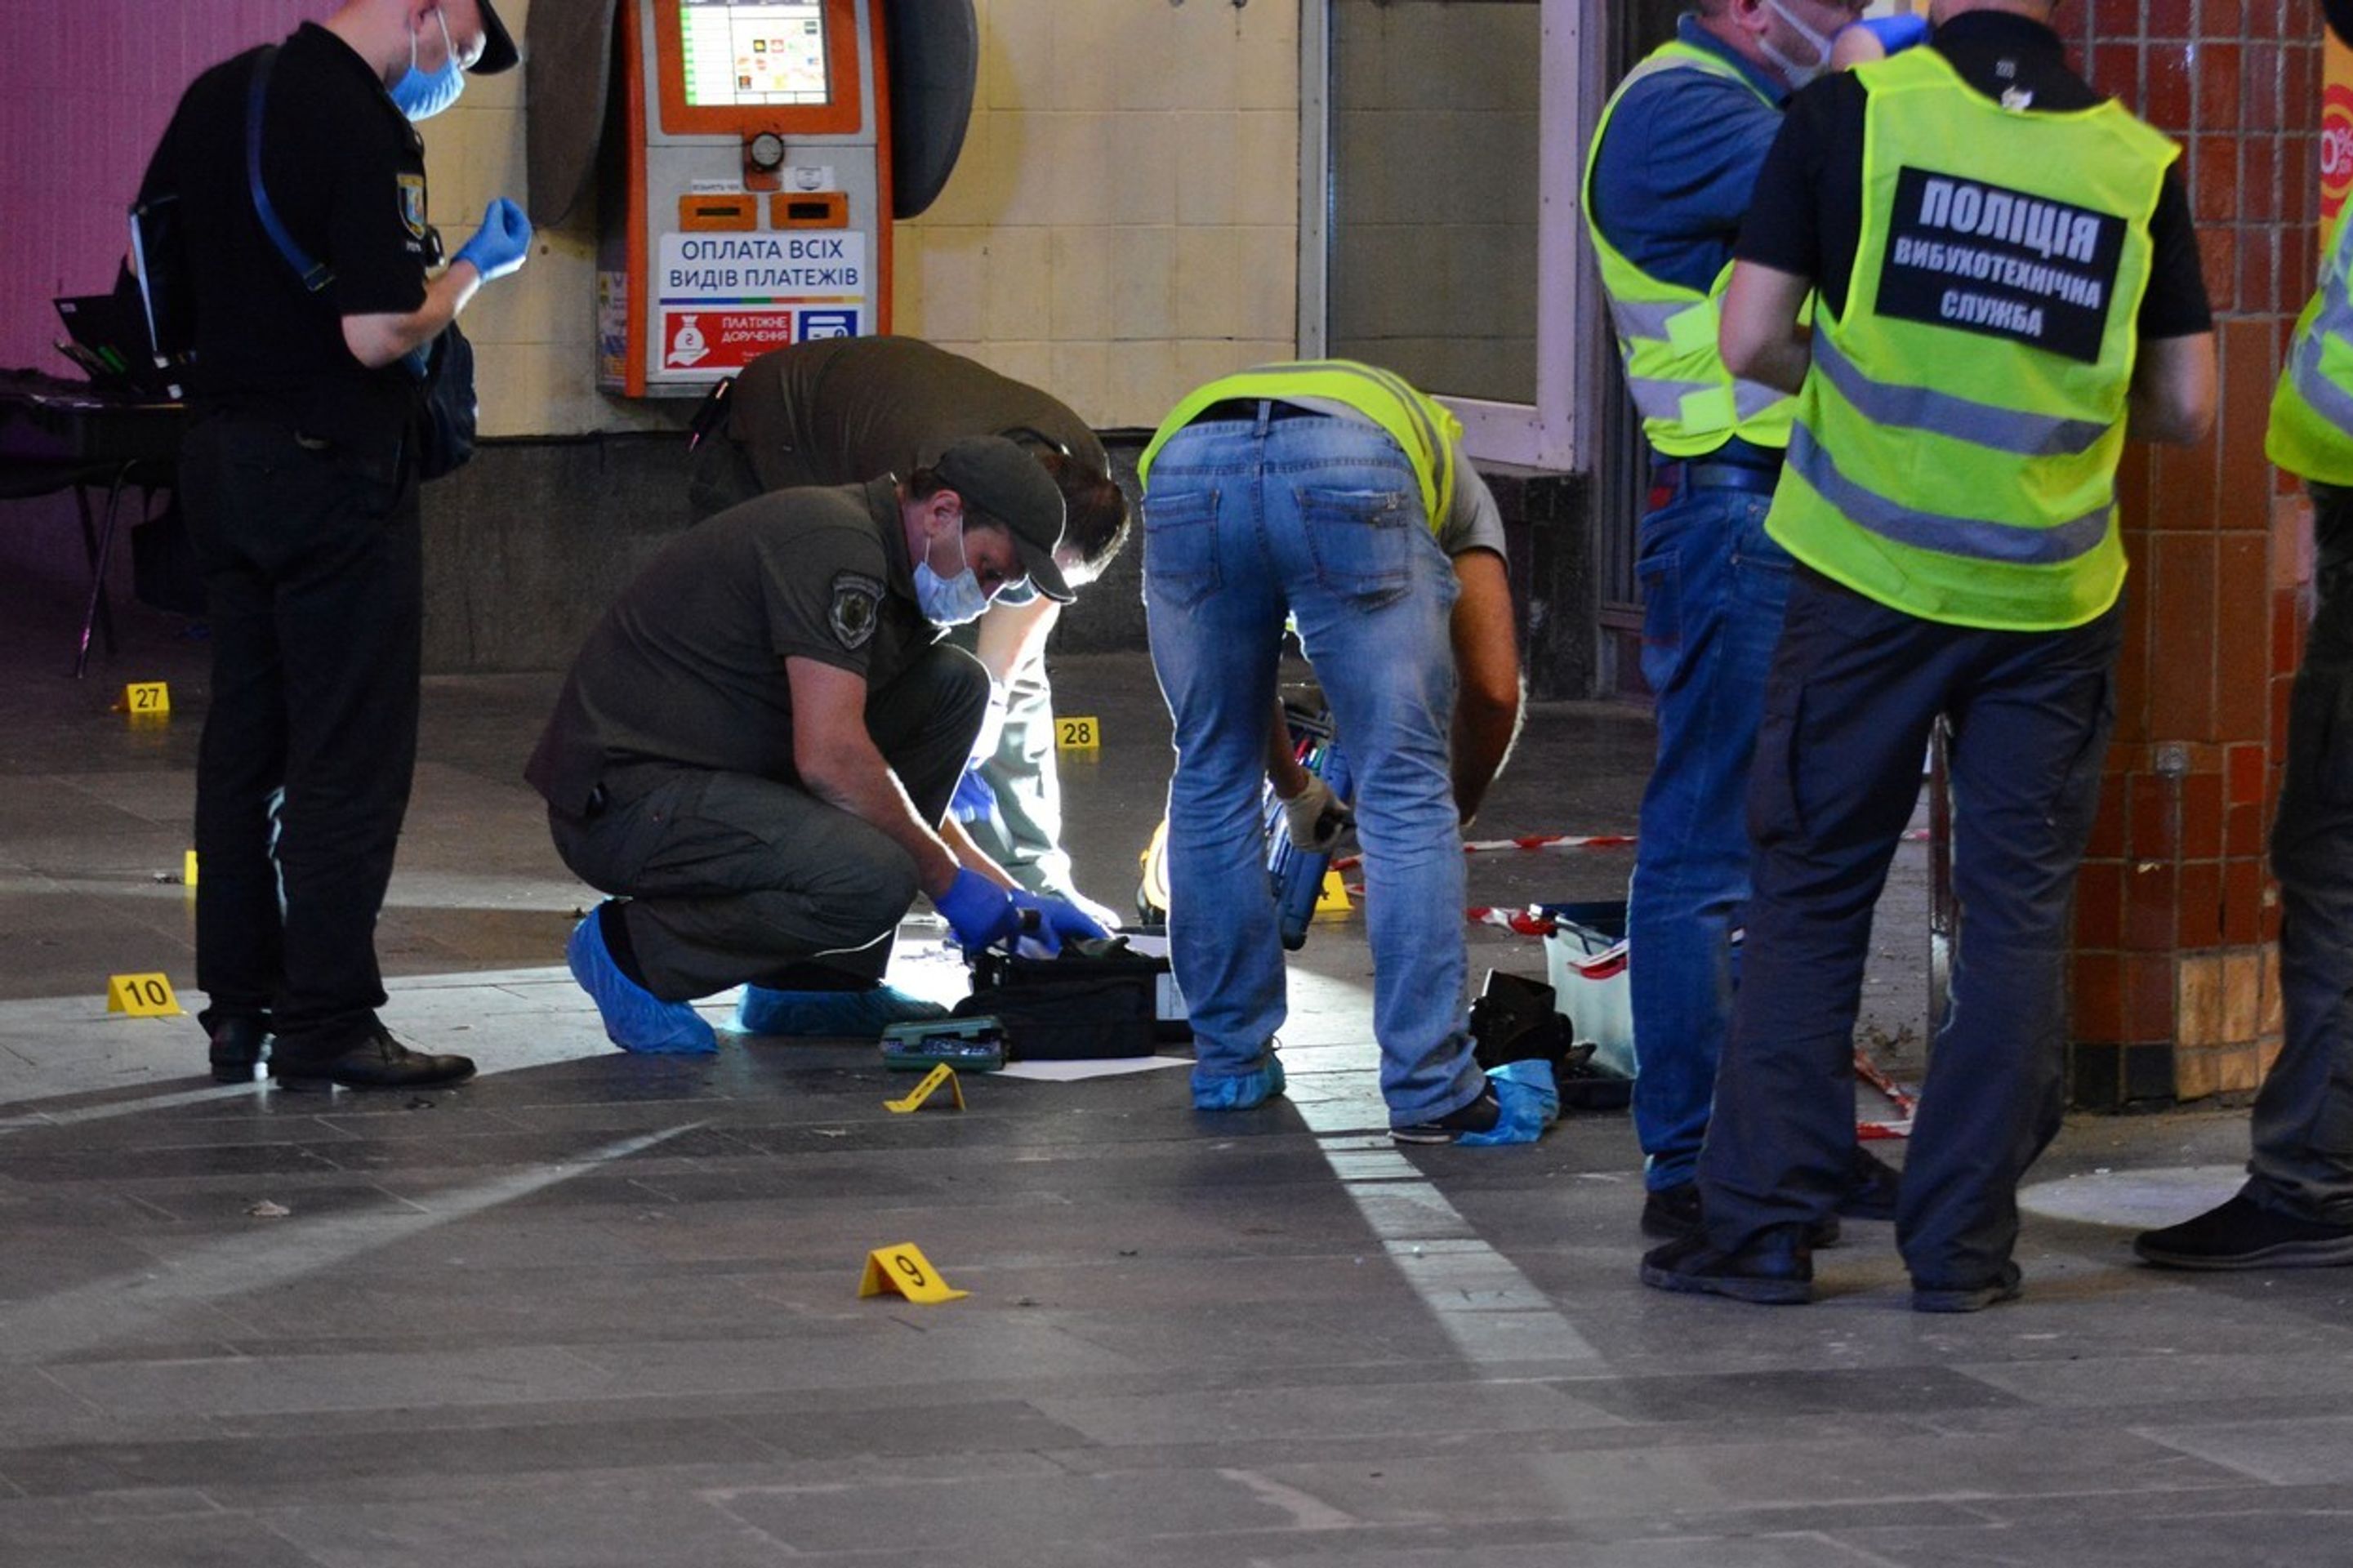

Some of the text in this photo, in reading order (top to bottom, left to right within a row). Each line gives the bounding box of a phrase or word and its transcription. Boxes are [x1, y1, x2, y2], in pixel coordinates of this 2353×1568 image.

[1918, 178, 2100, 263] ПОЛІЦІЯ
[681, 238, 844, 261] ОПЛАТА ВСІХ
[670, 268, 858, 290] ВИДІВ ПЛАТЕЖІВ
[1893, 236, 2102, 310] ВИБУХОТЕХНІЧНА
[1940, 289, 2044, 337] СЛУЖБА
[721, 330, 788, 343] ДОРУЧЕННЯ
[136, 688, 159, 708] 27
[1063, 723, 1090, 744] 28
[125, 980, 167, 1006] 10
[895, 1254, 925, 1286] 9
